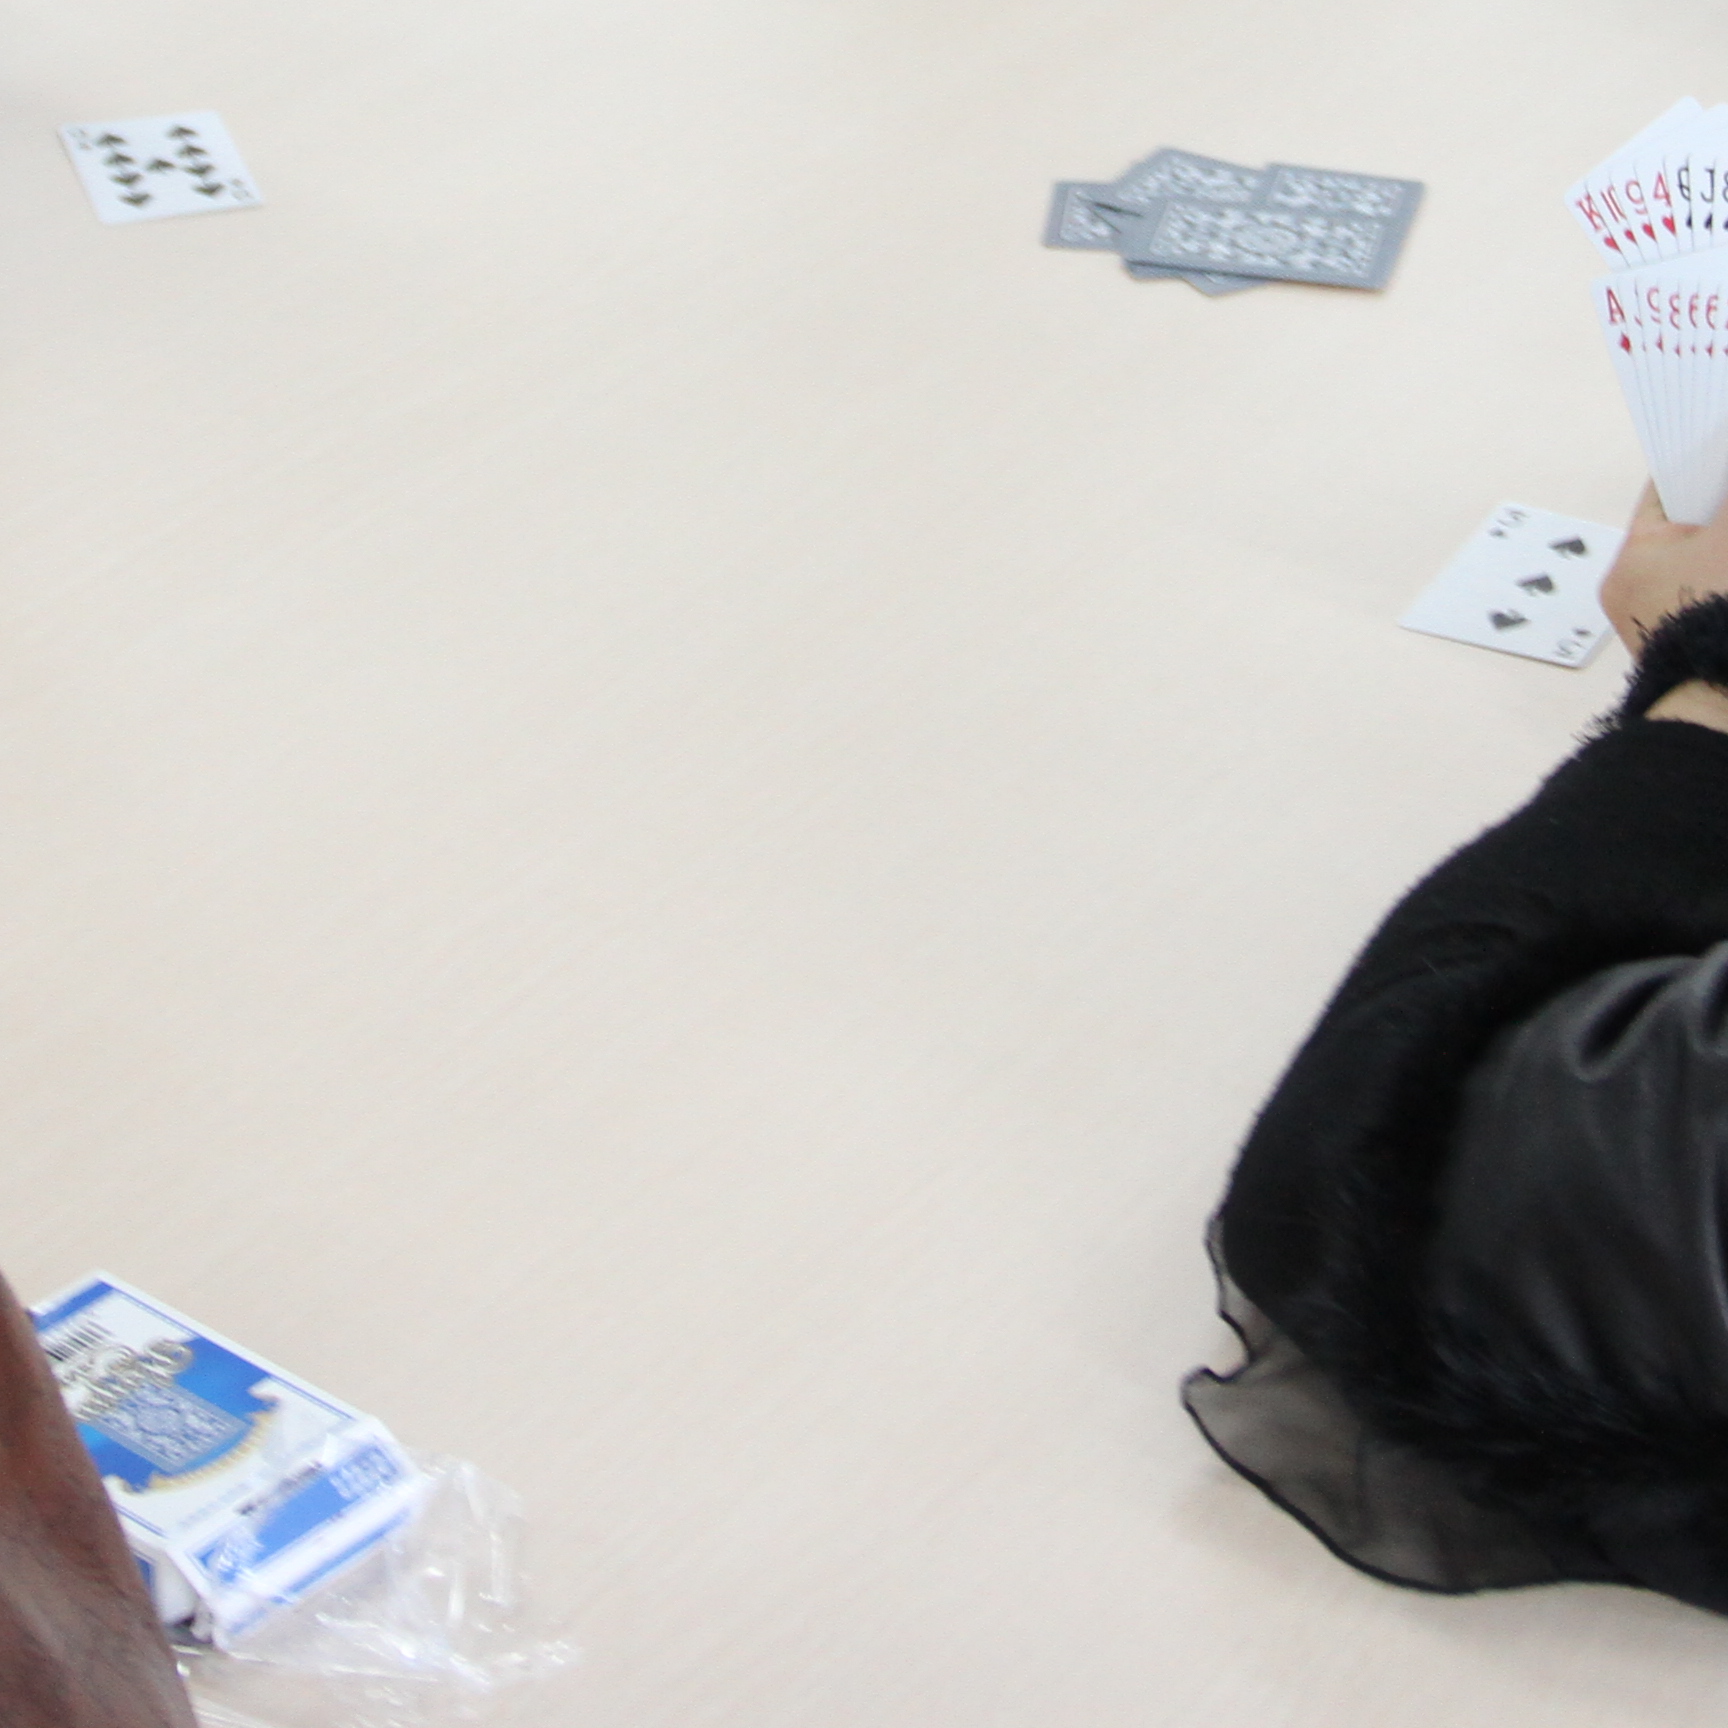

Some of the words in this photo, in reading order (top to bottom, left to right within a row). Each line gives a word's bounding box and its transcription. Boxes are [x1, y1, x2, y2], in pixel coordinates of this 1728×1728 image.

[1576, 193, 1605, 231] K
[1653, 171, 1672, 208] 4
[1700, 168, 1714, 203] J
[1606, 286, 1626, 325] A
